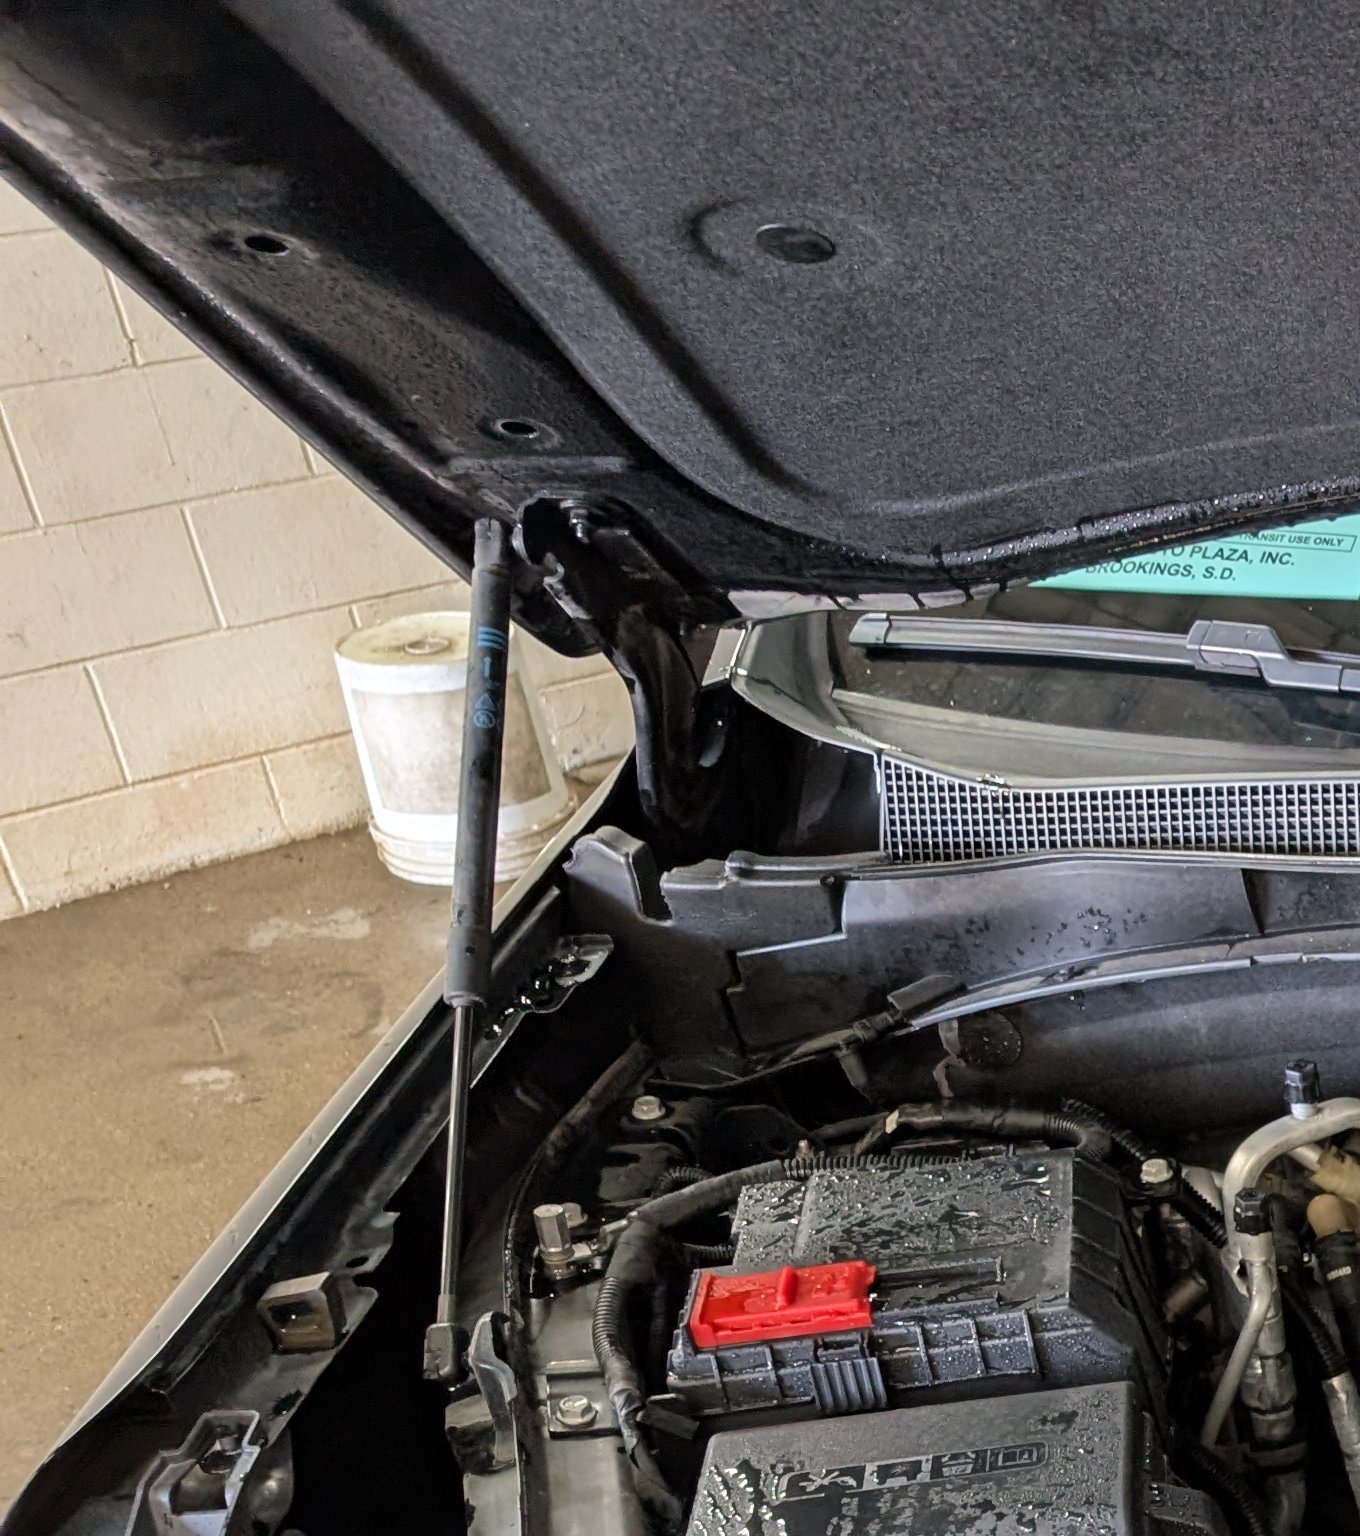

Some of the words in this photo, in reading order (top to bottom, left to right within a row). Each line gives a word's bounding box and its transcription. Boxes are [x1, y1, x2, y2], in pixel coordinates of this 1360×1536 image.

[1288, 535, 1311, 545] USE
[1313, 536, 1344, 547] ONLY
[1189, 545, 1253, 565] PLAZA,
[1259, 551, 1295, 566] INC.
[1085, 560, 1195, 580] BROOKINGS,
[1202, 565, 1236, 581] S.D.
